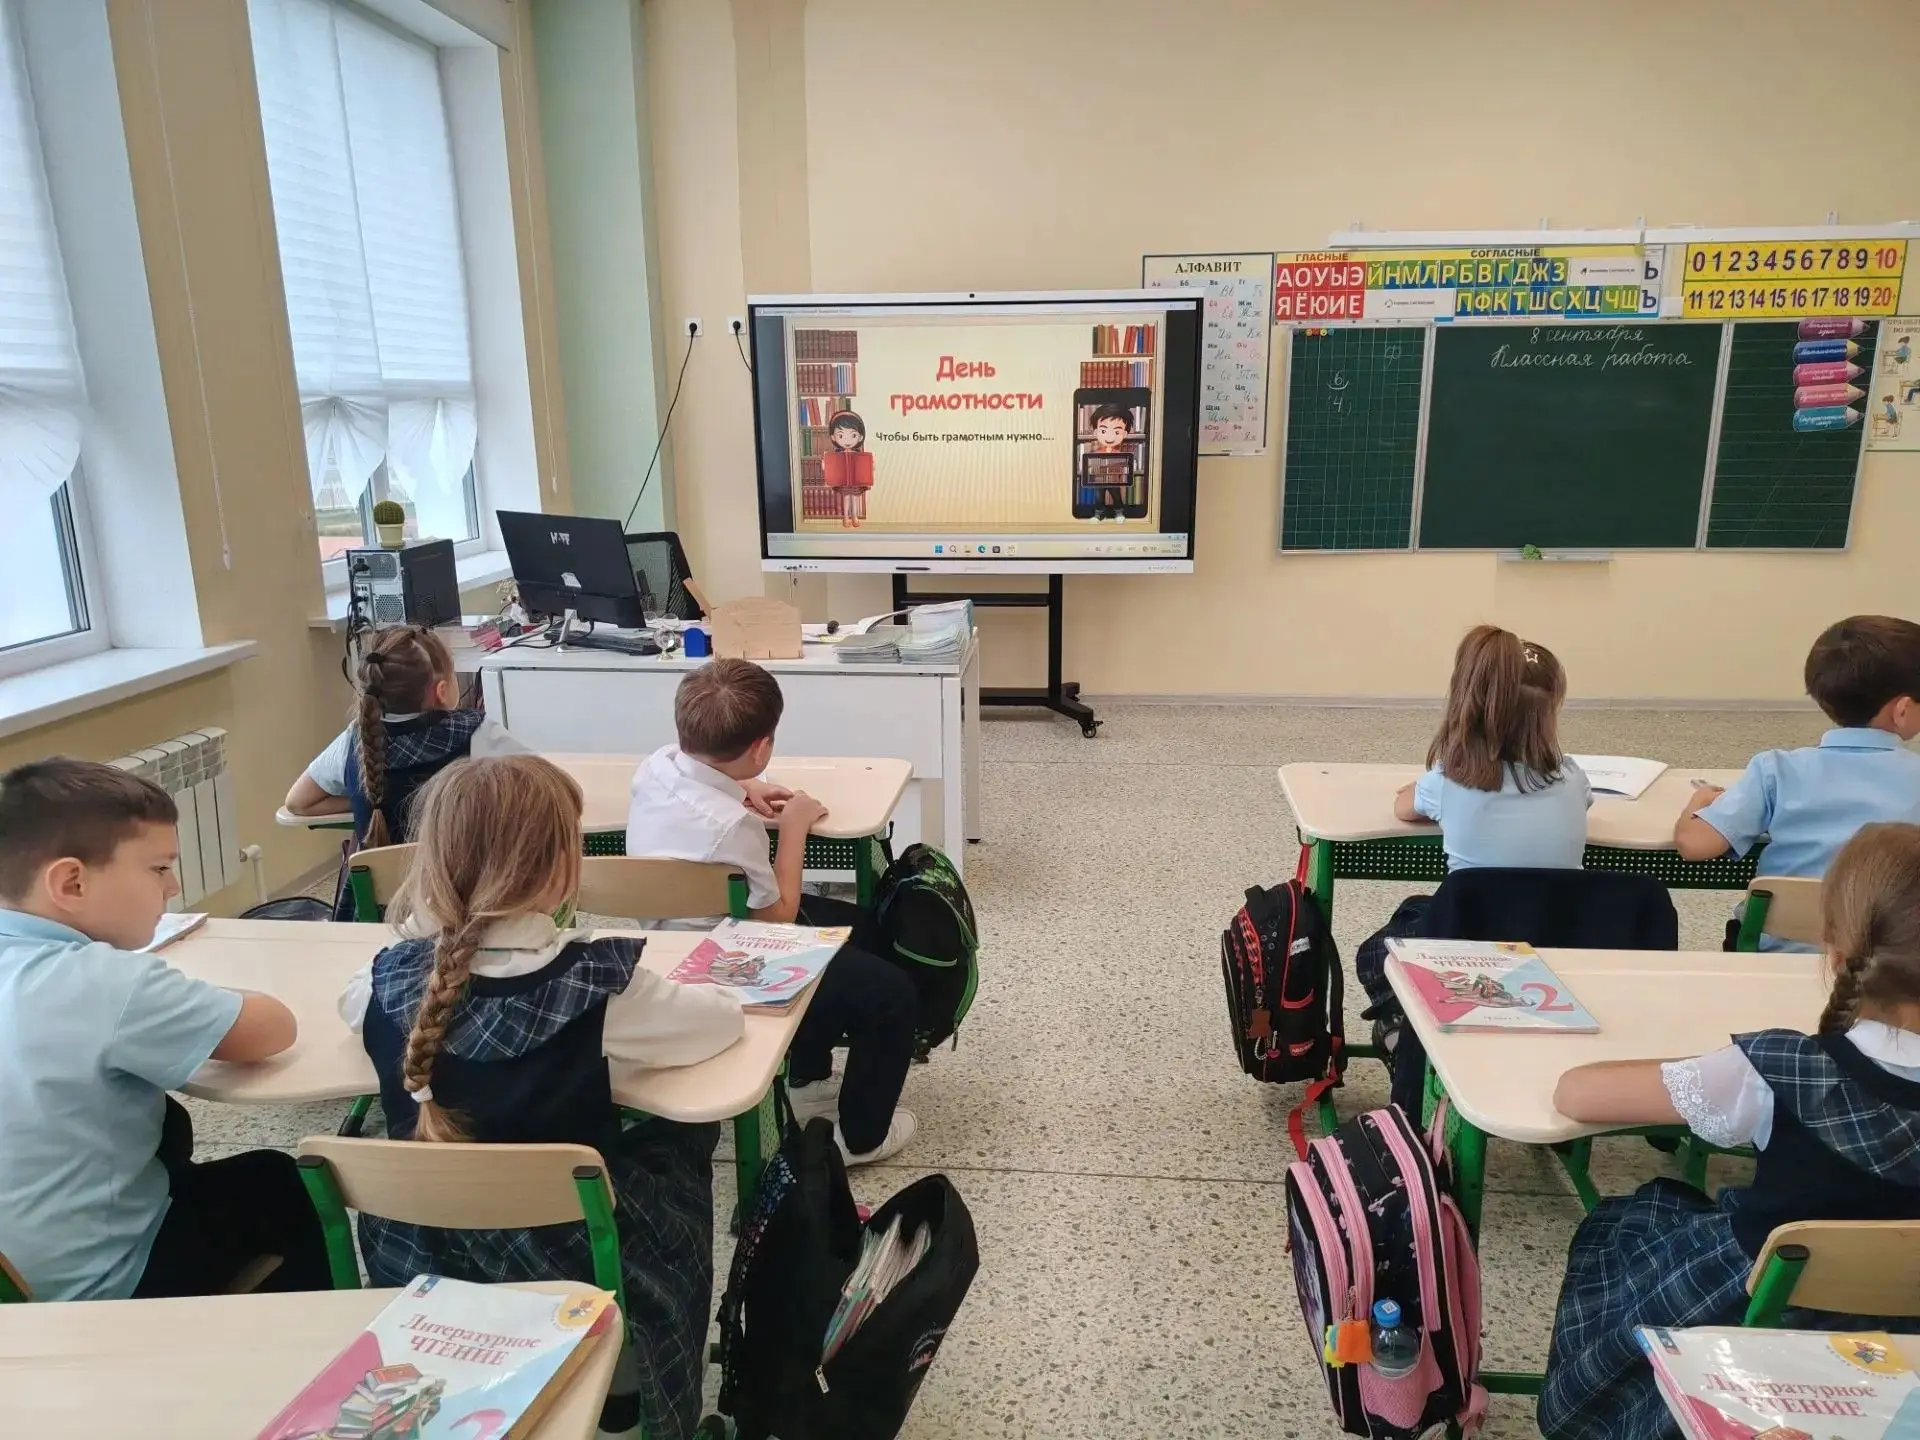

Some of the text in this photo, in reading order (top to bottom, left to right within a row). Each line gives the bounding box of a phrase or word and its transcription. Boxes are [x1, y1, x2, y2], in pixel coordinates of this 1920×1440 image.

[1296, 252, 1349, 262] ГЛАСНЫЕ
[1470, 248, 1540, 258] СОГЛАСНЫЕ
[1692, 248, 1897, 272] 0 1 2 3 4 5 6 7 8 9 10
[1175, 262, 1242, 274] АЛФАВИТ
[1644, 260, 1658, 280] Ь
[1642, 290, 1657, 309] Ъ
[1688, 286, 1892, 309] 11 12 13 14 15 16 17 18 19 20
[1530, 327, 1540, 344] 8
[936, 356, 996, 382] День
[1490, 344, 1696, 373] Классная работа
[1334, 370, 1343, 386] 6
[890, 392, 1043, 416] грамотности
[1333, 396, 1344, 413] 4
[876, 432, 910, 442] Чтобы
[912, 432, 939, 441] быть
[942, 433, 1004, 443] грамотным
[760, 965, 809, 992] 2
[1520, 982, 1574, 1012] 2
[400, 1313, 541, 1350] Литературное
[410, 1335, 508, 1366] ЧТЕНИЕ
